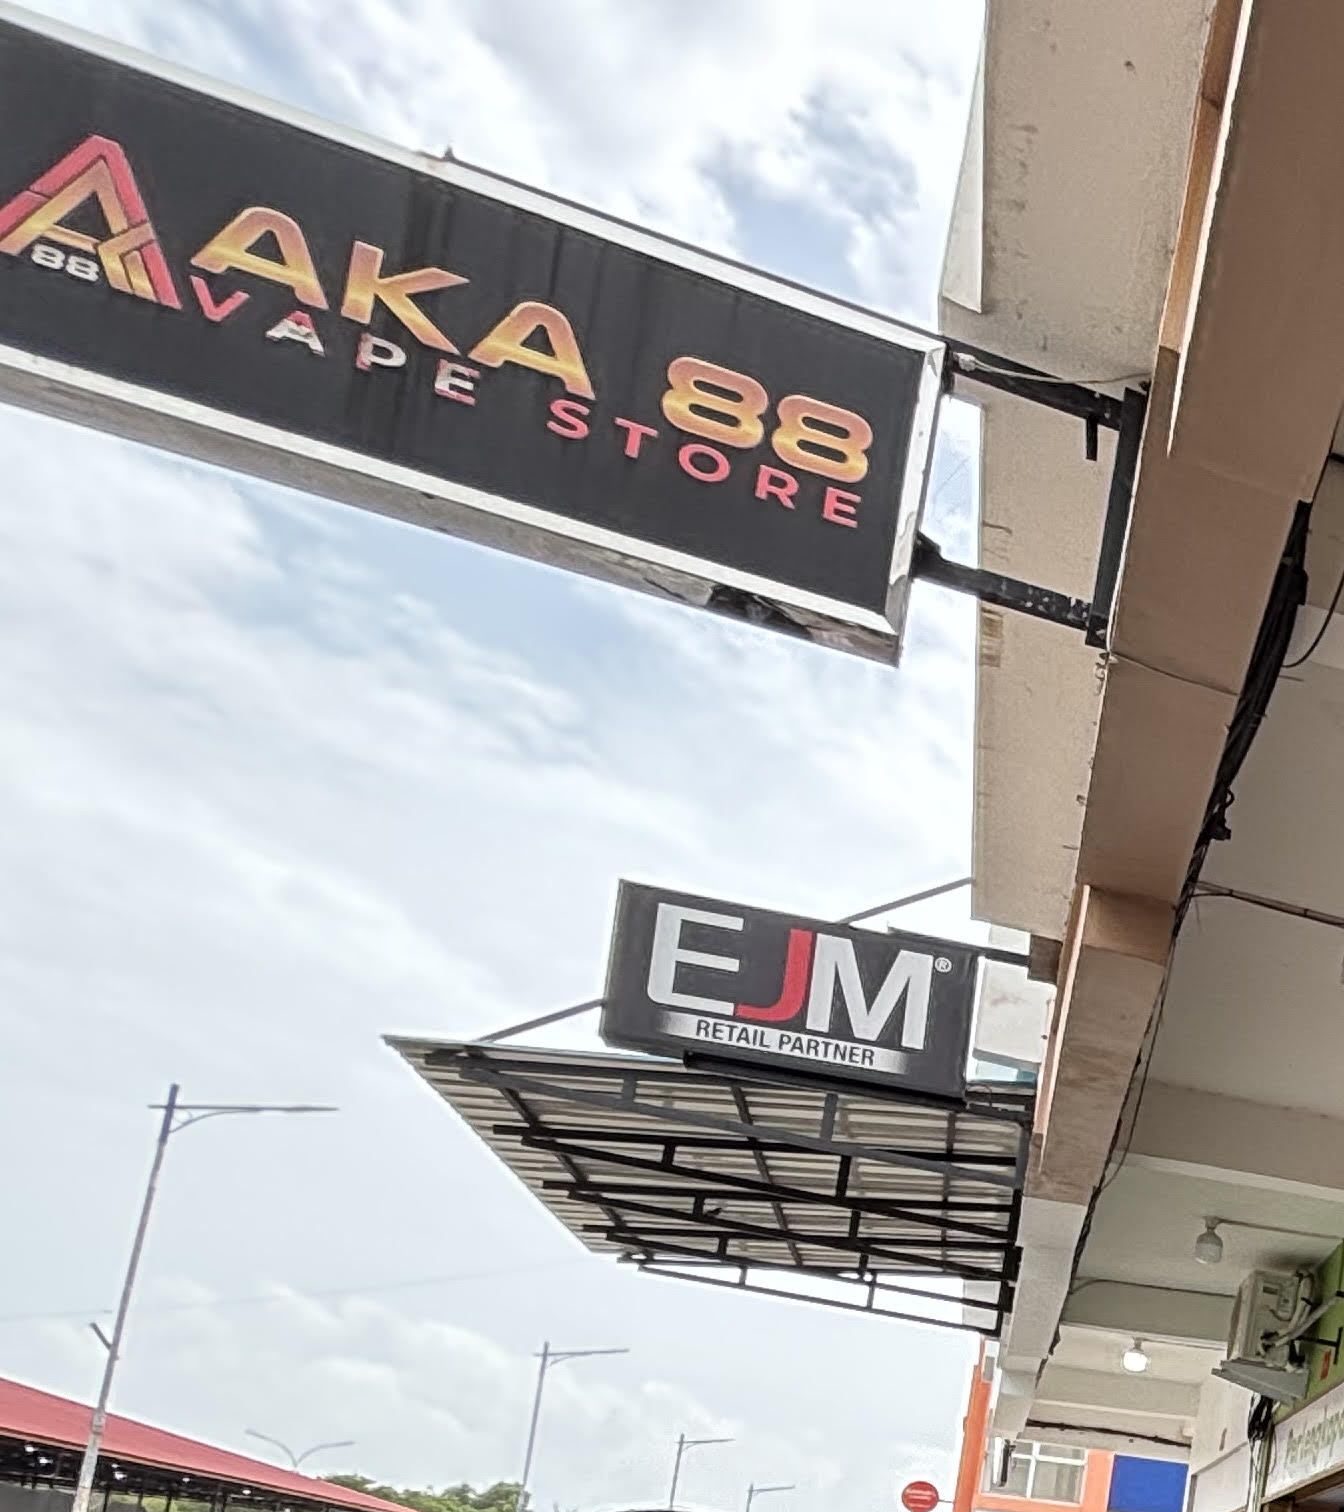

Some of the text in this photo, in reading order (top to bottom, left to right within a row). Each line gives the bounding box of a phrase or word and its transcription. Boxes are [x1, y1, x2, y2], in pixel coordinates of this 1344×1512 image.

[30, 244, 101, 285] 88
[190, 206, 874, 484] AKA 88
[190, 275, 862, 529] VAPE STORE
[647, 902, 935, 1050] EJM
[696, 1018, 875, 1067] RETAIL PARTNER
